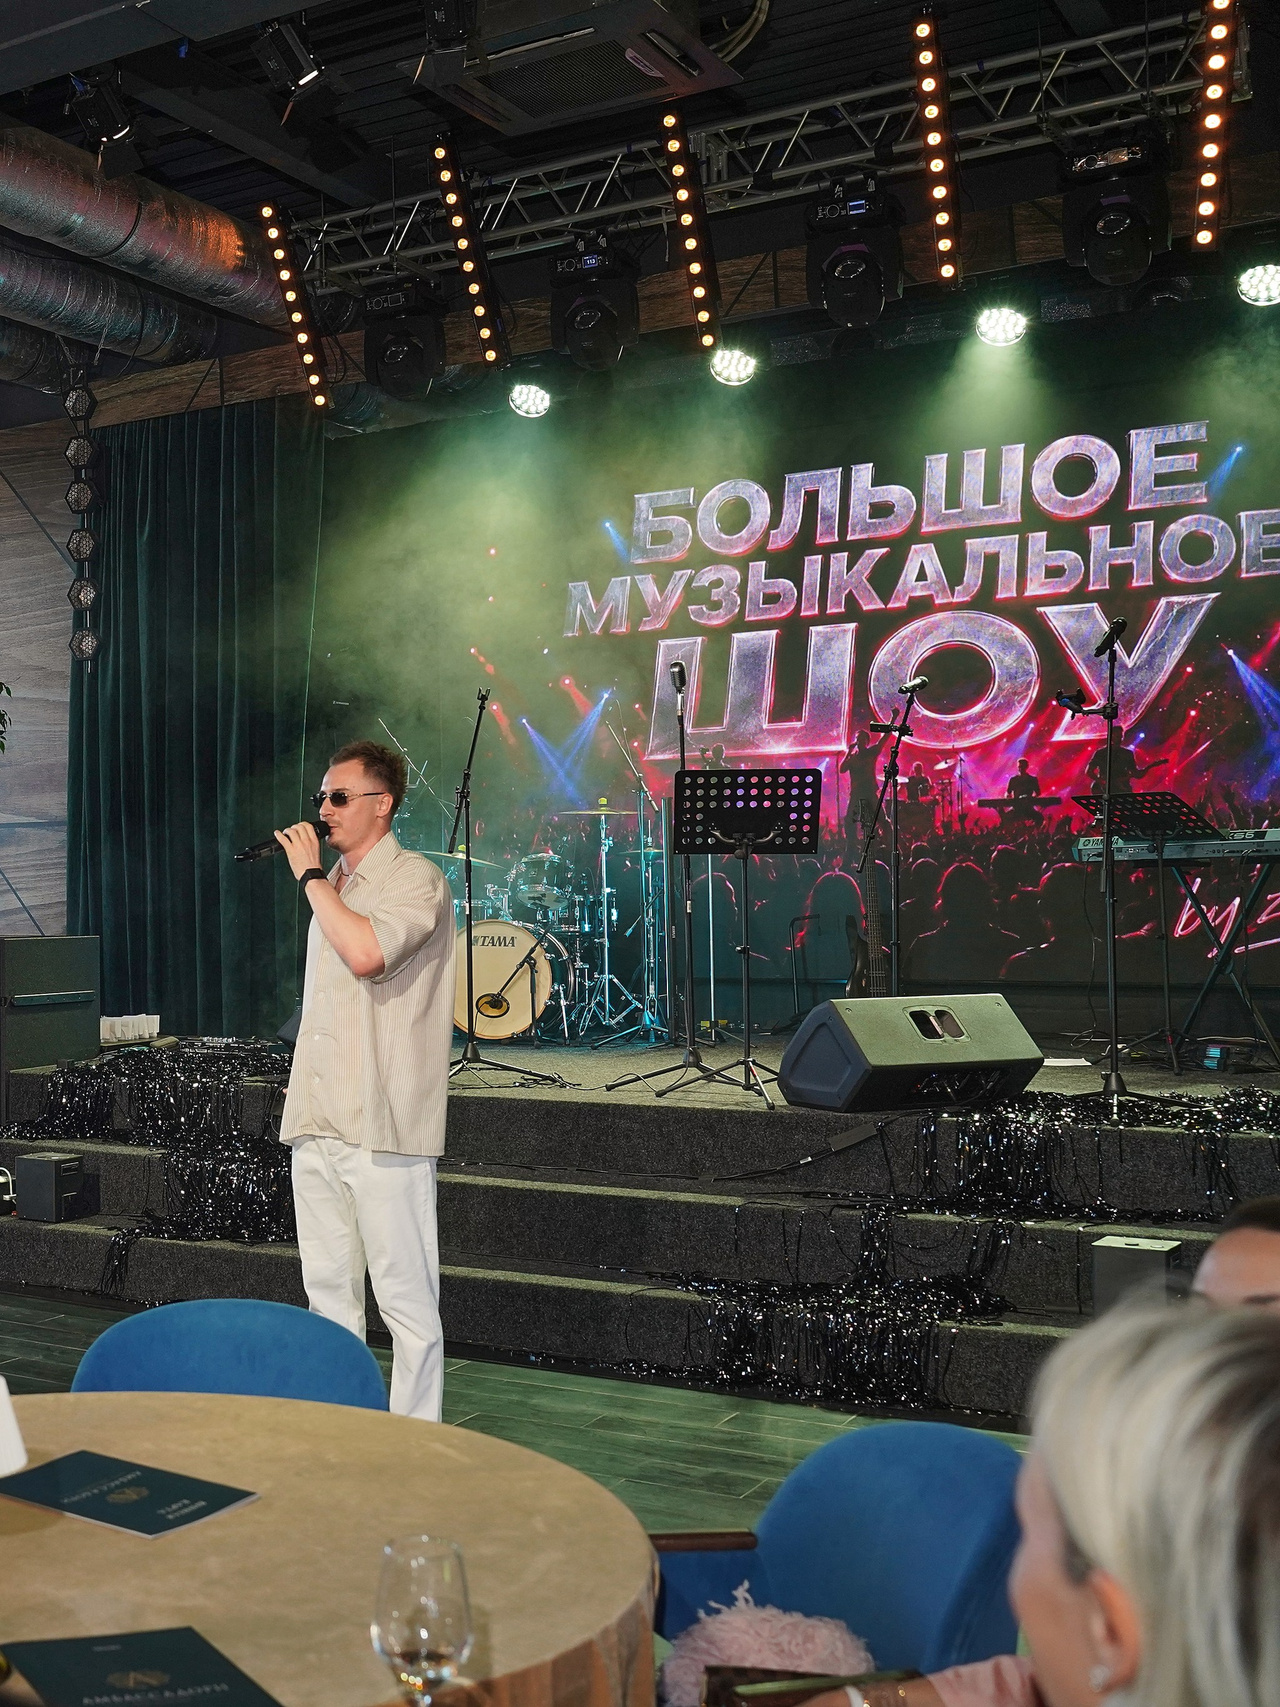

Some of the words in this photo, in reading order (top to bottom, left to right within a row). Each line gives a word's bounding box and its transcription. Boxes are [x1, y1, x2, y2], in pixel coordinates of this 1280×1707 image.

[631, 420, 1210, 564] БОЛЬШОЕ
[563, 509, 1280, 638] МУЗЫКАЛЬНОЕ
[645, 592, 1223, 760] ШОУ
[479, 935, 516, 947] TAMA
